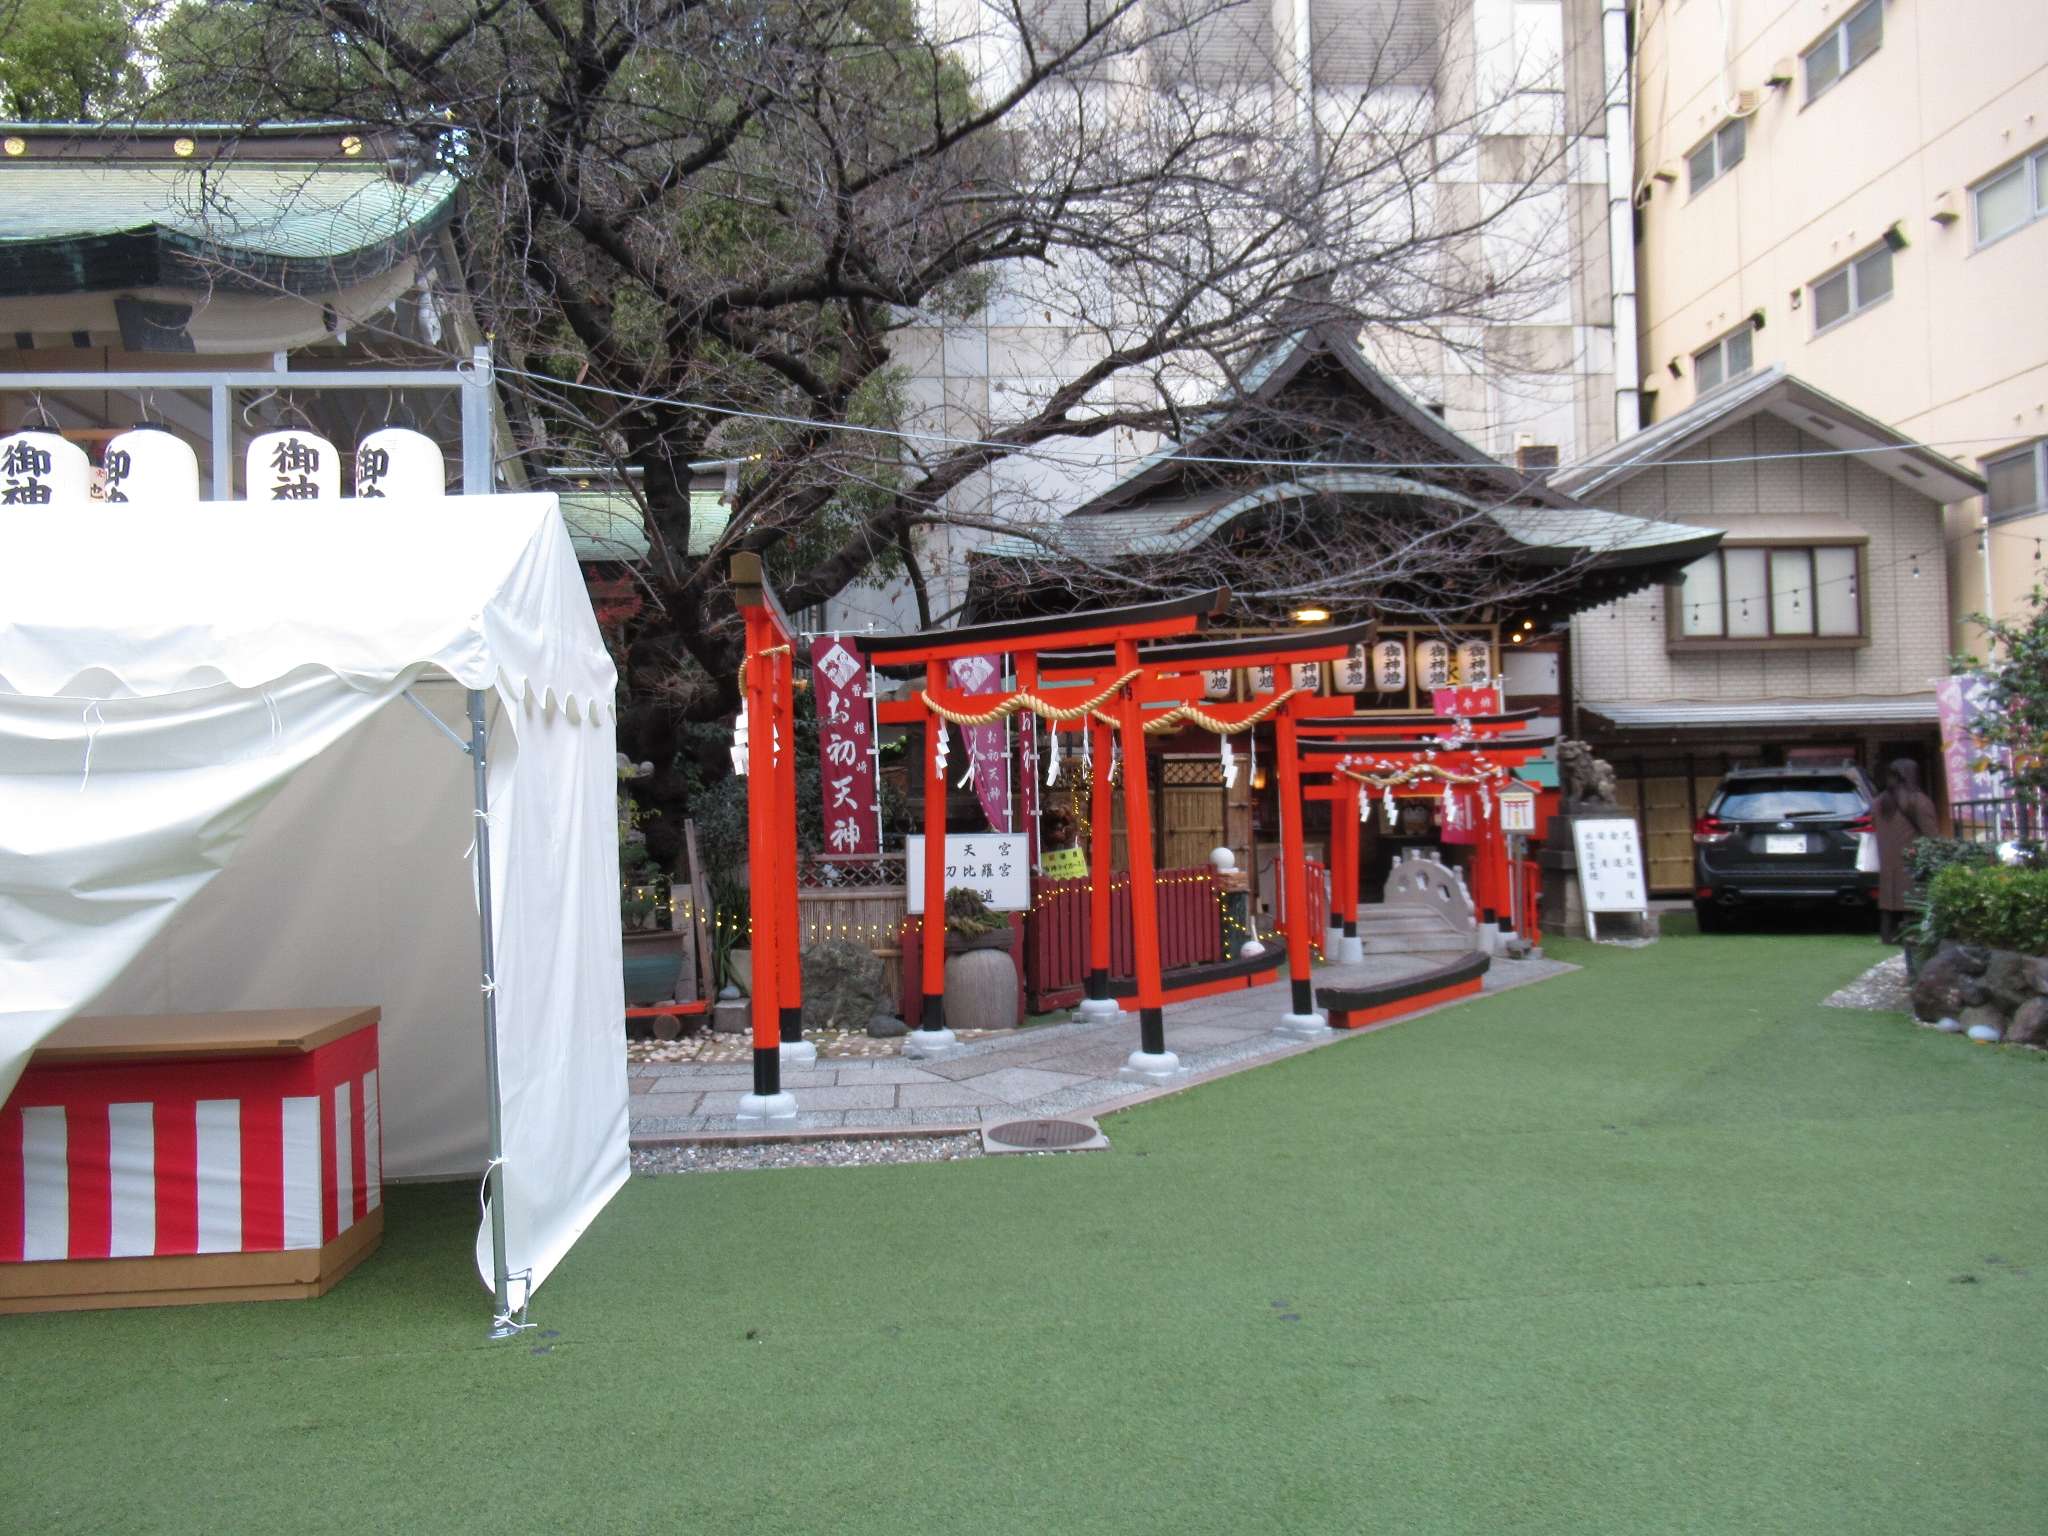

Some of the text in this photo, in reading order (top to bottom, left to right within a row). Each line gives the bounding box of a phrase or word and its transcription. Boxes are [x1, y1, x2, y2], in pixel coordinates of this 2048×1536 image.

[827, 691, 861, 854] お初天神
[986, 730, 1001, 802] お初天神
[980, 888, 994, 903] 道
